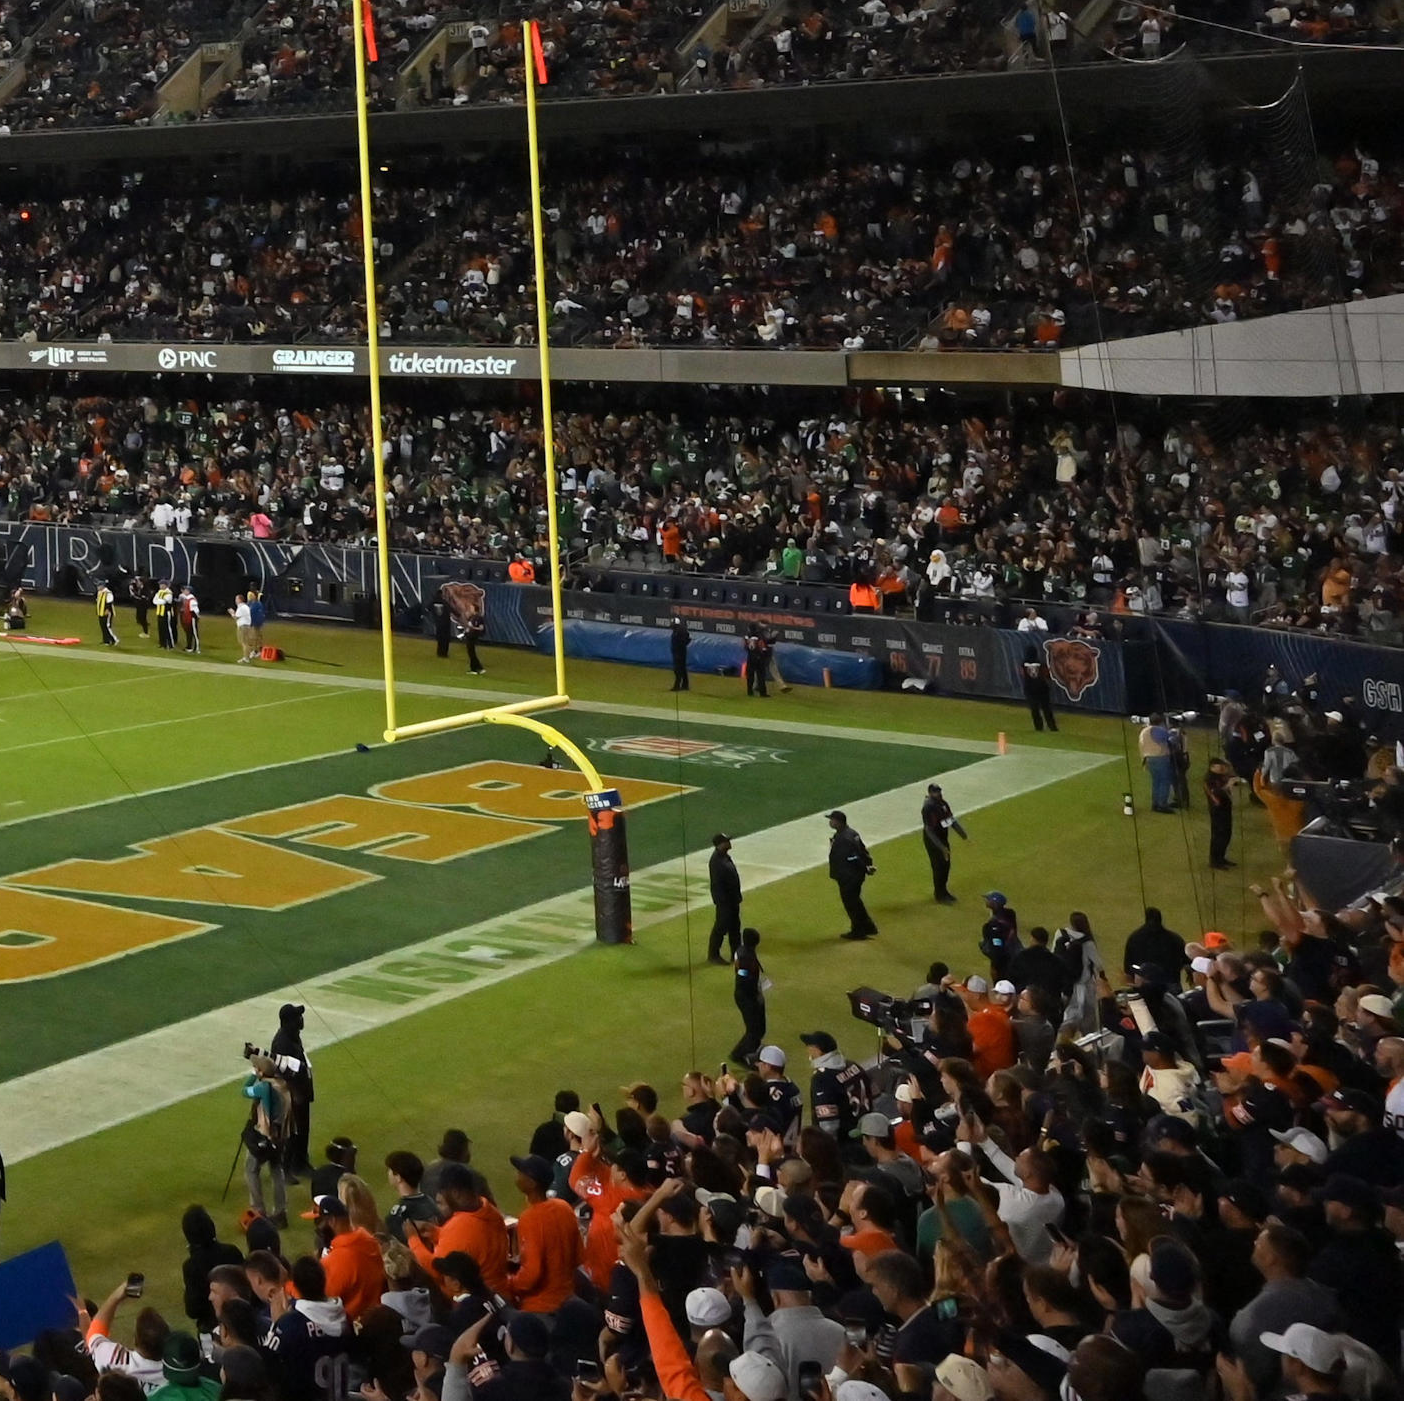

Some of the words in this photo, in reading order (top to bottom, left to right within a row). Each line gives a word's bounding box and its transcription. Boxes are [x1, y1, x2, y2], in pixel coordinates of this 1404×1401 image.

[179, 351, 217, 368] PNC
[273, 350, 354, 366] GRAINGER
[389, 353, 516, 375] ticketmaster
[1363, 678, 1402, 712] GSH
